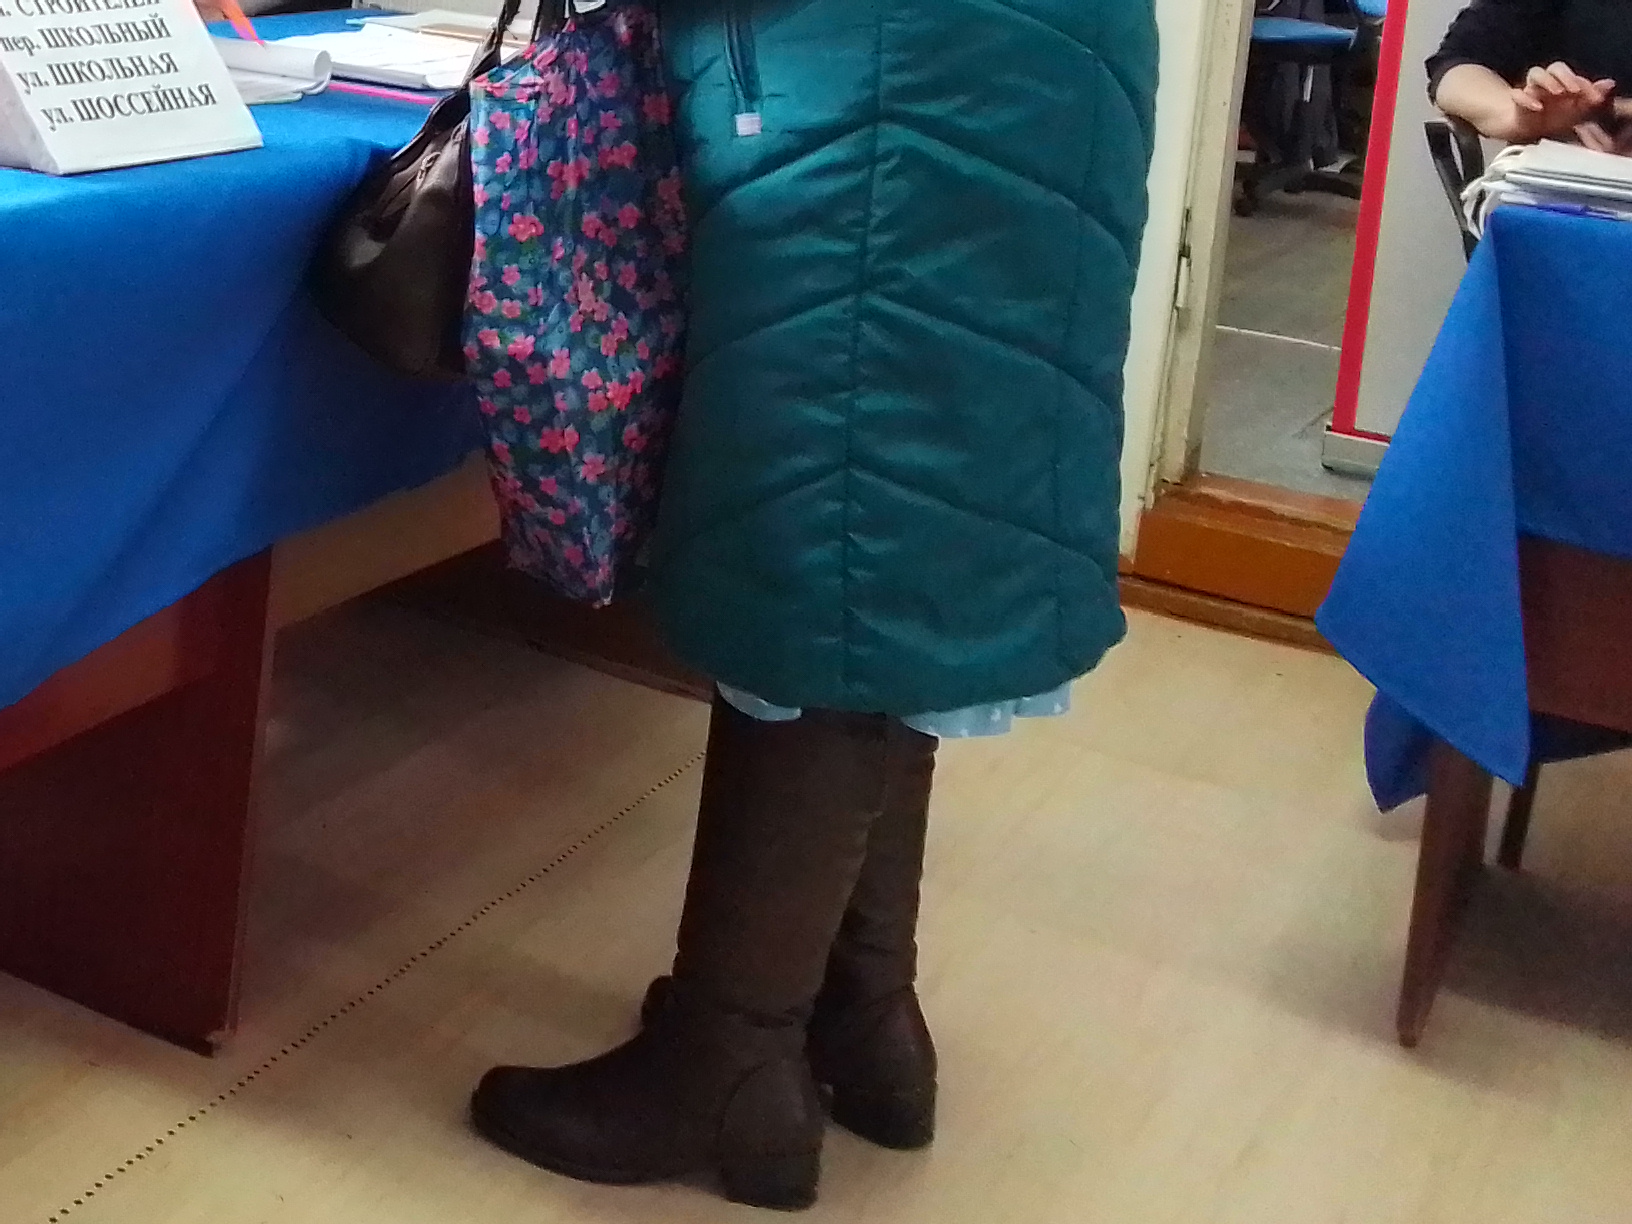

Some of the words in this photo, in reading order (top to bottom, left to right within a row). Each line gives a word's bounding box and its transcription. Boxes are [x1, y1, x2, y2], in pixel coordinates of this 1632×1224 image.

[38, 12, 173, 51] ШКОЛЬНЫЙ
[18, 72, 50, 95] ул.
[48, 52, 180, 87] ШКОЛЬНАЯ
[41, 107, 74, 132] ул.
[70, 83, 218, 122] ШОССЕЙНАЯ
